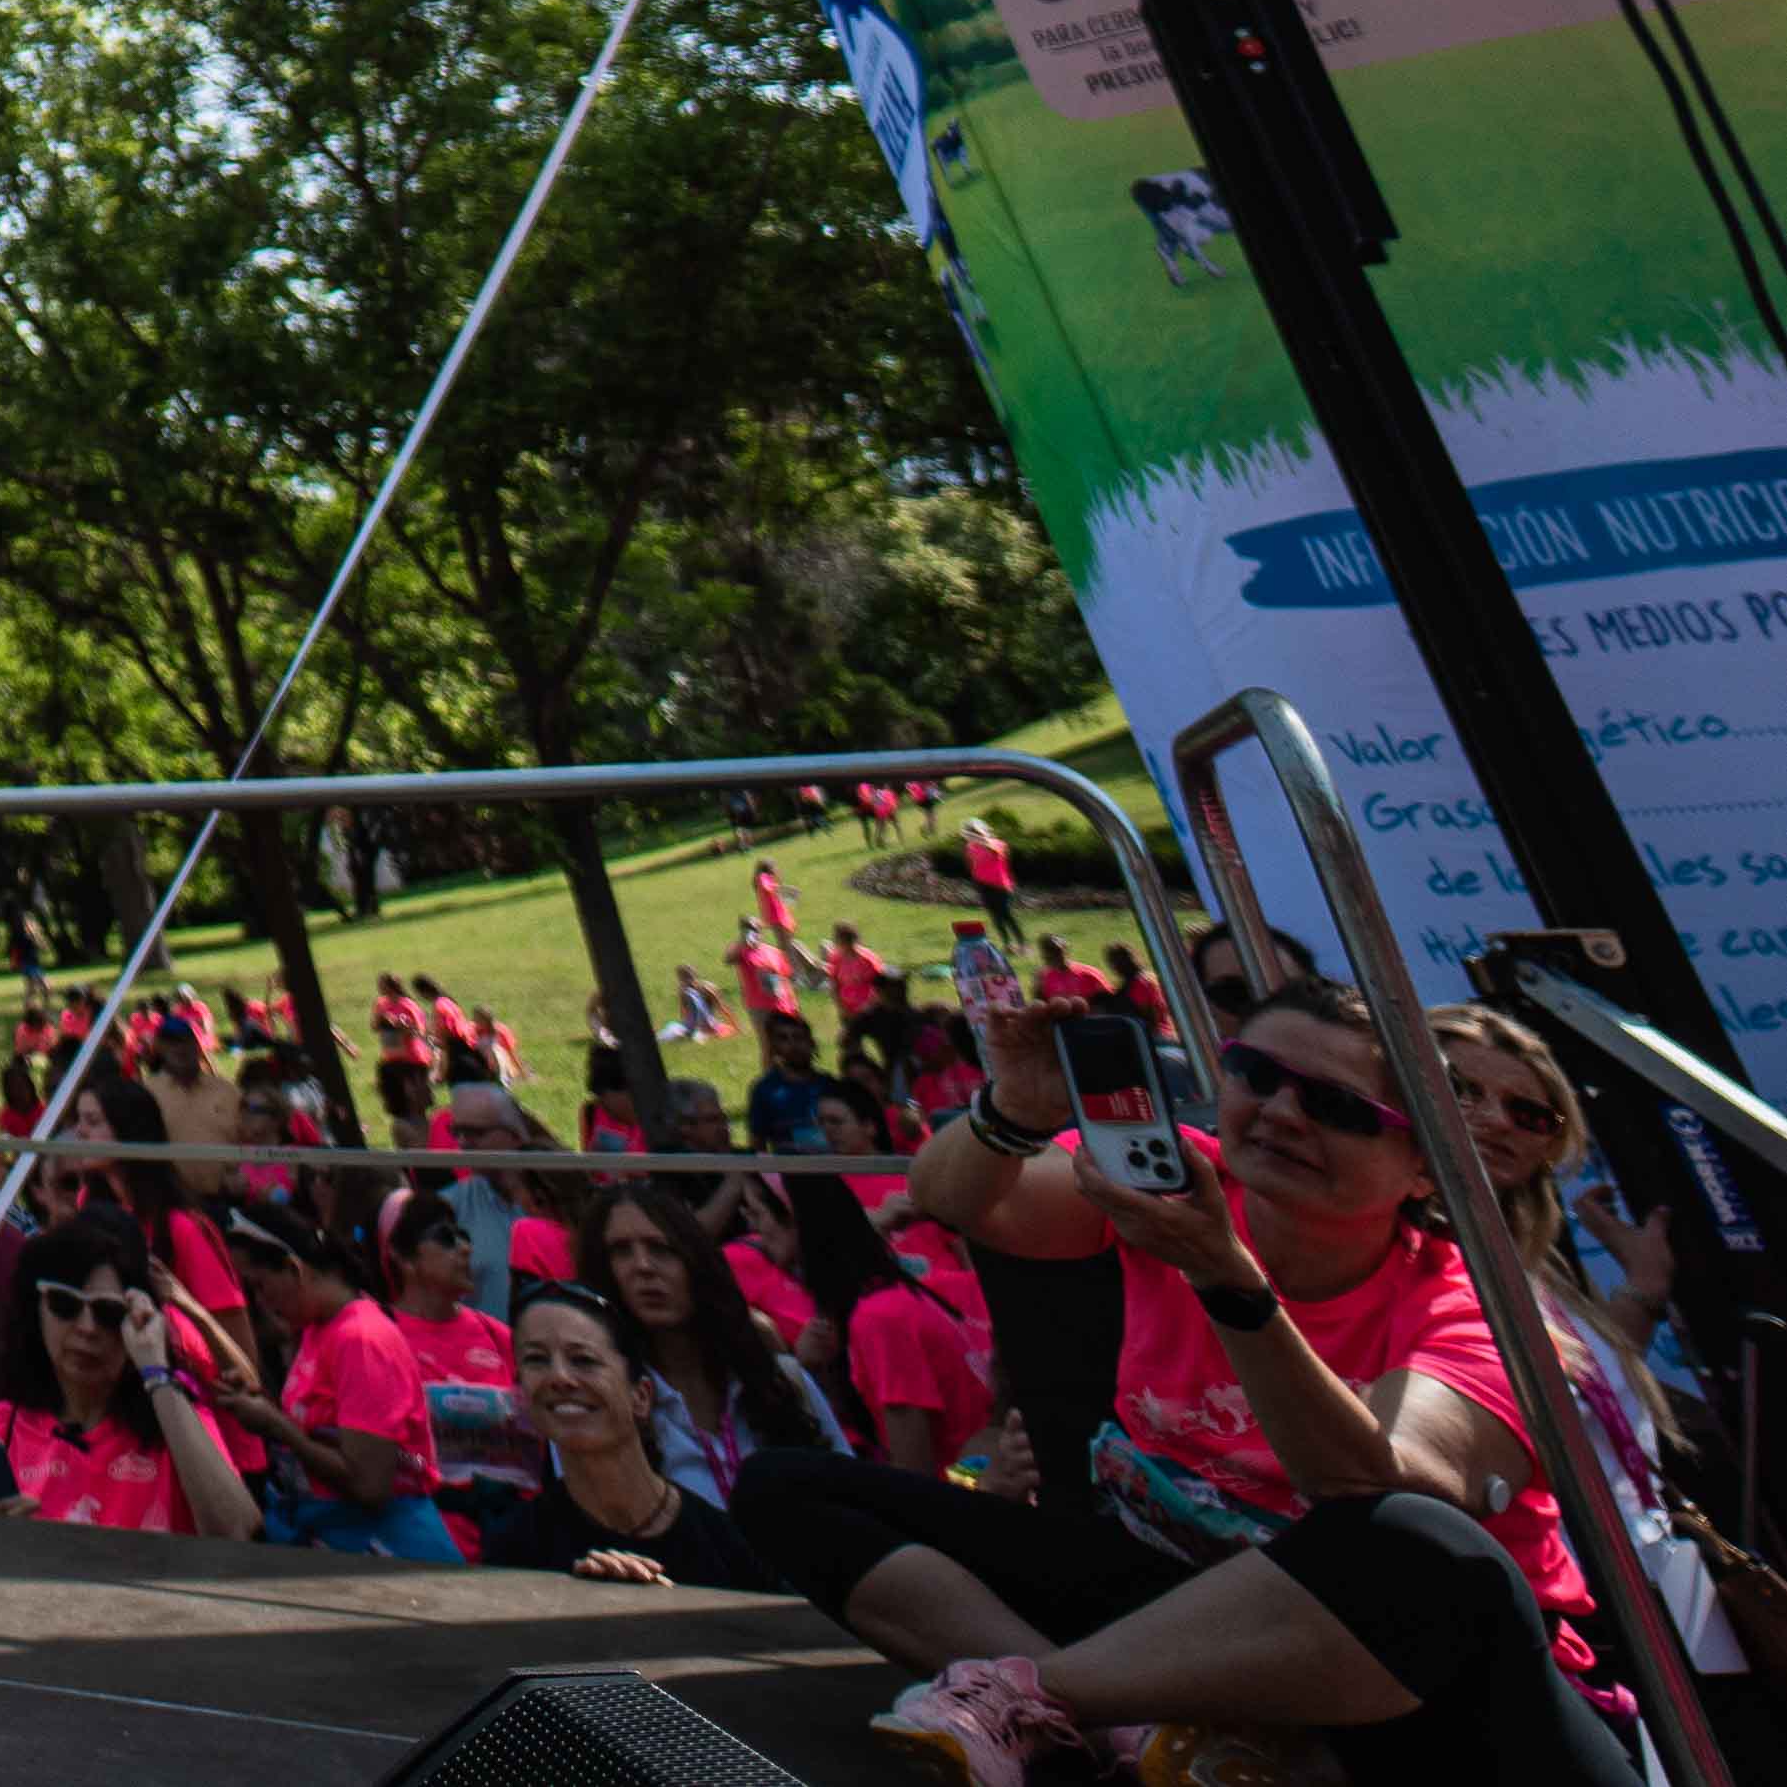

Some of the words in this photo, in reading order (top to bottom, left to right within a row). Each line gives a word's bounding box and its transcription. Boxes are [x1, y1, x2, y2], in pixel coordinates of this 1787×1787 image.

[1032, 19, 1085, 49] PARA
[1583, 599, 1740, 654] MEDIOS
[1329, 723, 1444, 767] Valor
[1426, 856, 1483, 896] de
